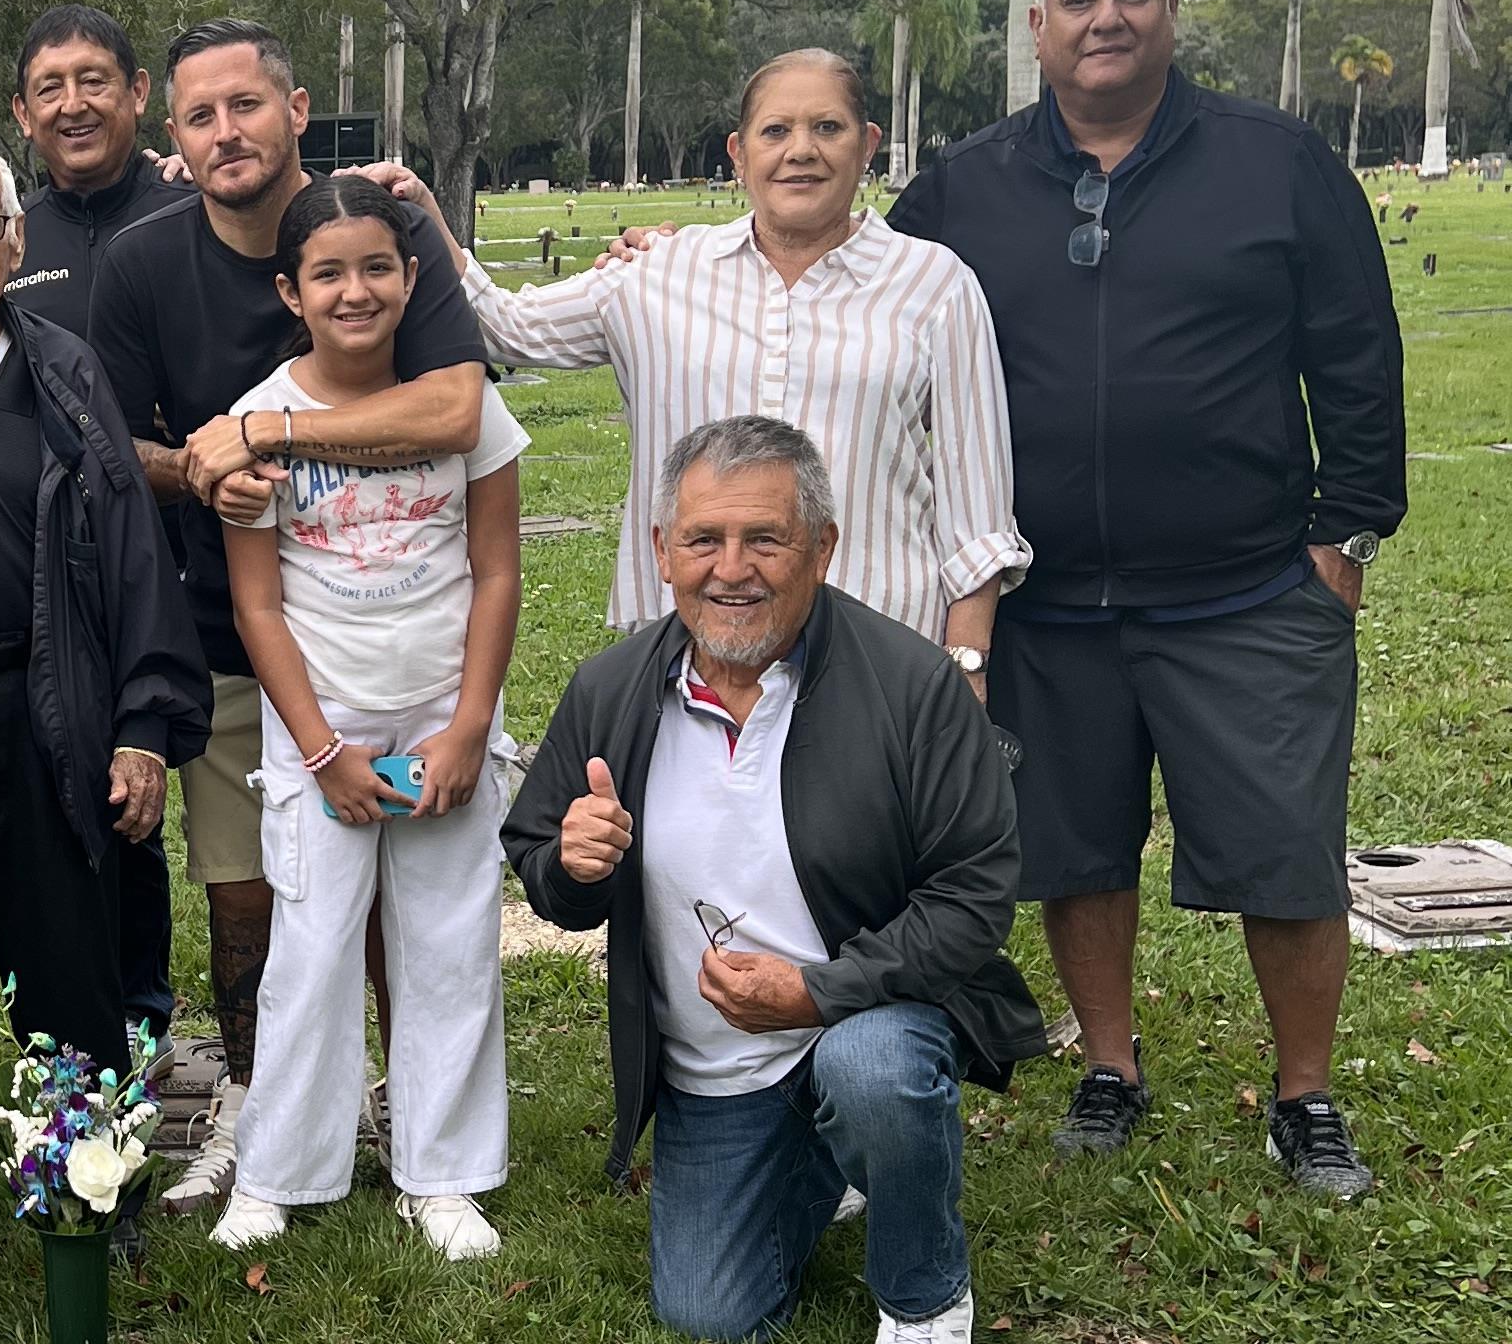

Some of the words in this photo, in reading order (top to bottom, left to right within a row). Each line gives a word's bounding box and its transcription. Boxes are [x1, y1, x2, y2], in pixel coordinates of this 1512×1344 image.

[4, 267, 69, 293] marathon
[320, 577, 361, 600] AWESOME
[365, 585, 397, 600] PLACE
[399, 578, 413, 592] TO
[412, 560, 431, 580] RIDE
